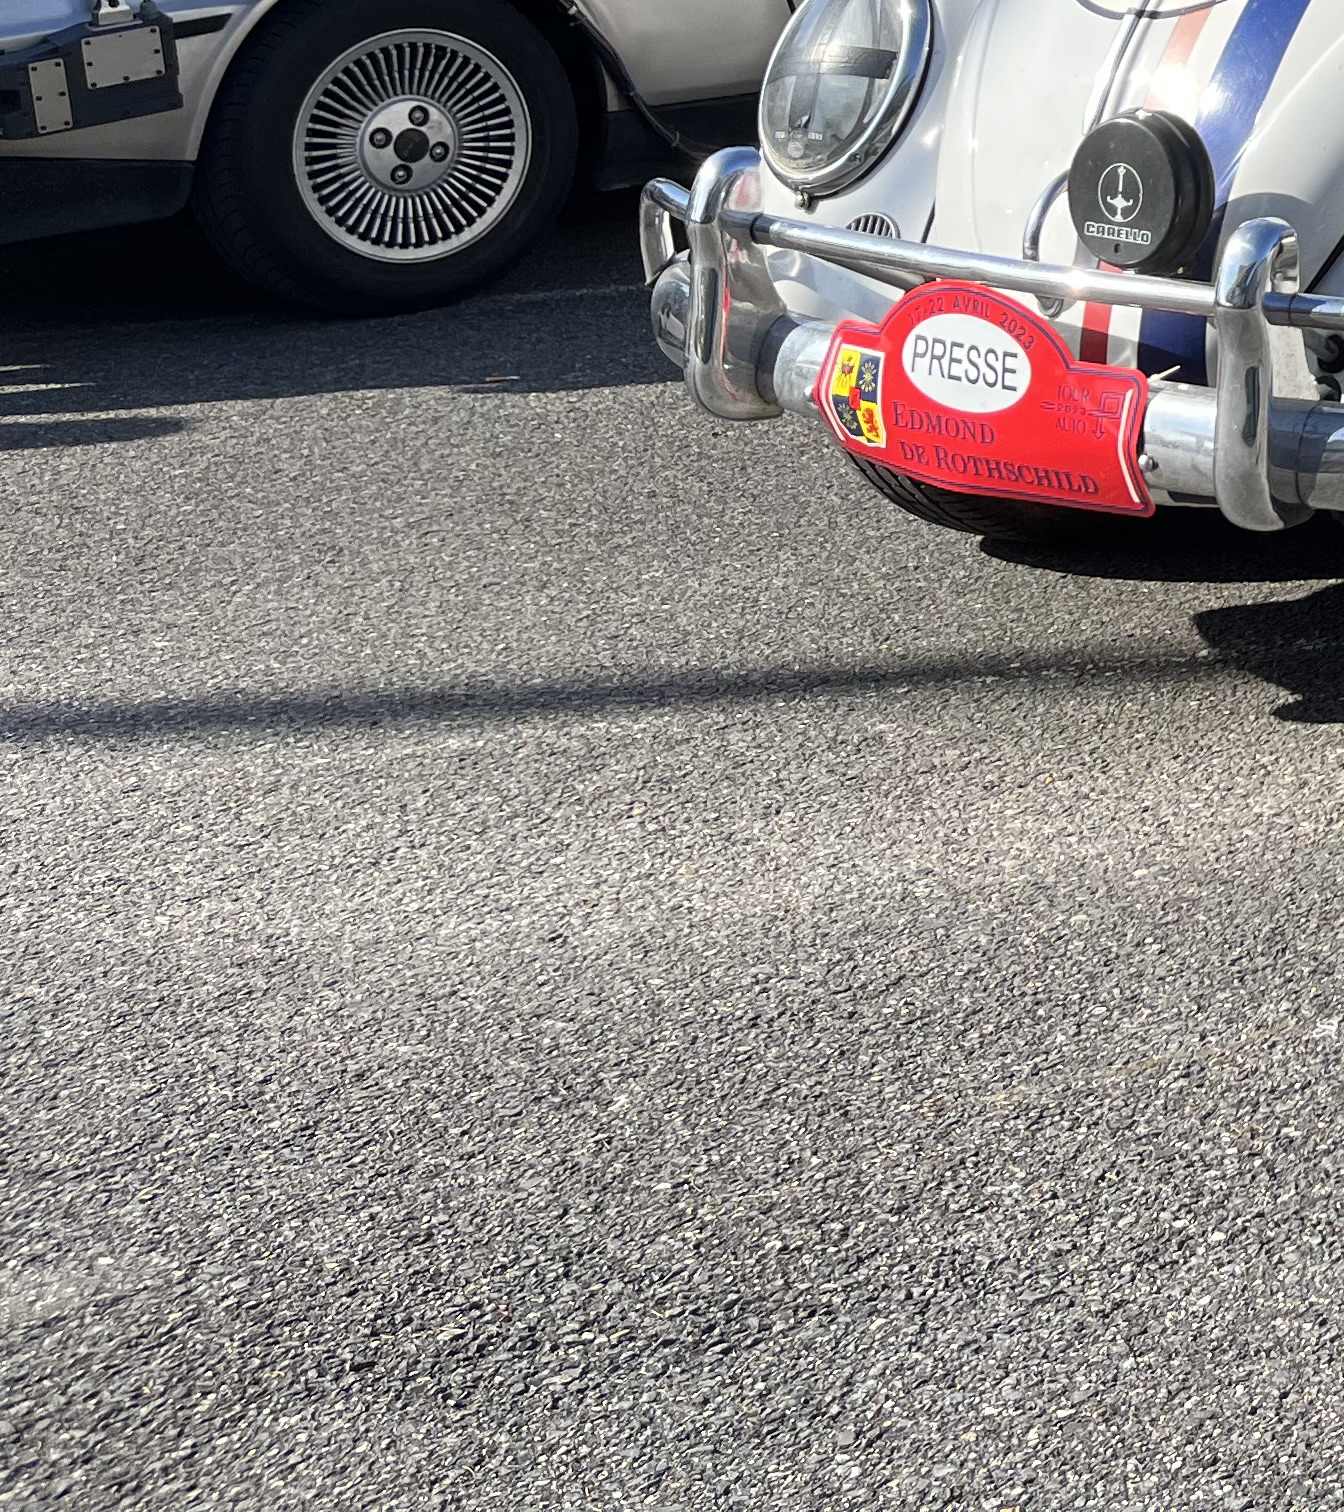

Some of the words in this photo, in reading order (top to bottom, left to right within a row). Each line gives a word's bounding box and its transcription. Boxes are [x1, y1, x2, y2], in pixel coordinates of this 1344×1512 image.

[1084, 221, 1151, 245] CARELLO
[952, 296, 991, 318] AVRIL
[999, 312, 1035, 350] 2023
[911, 334, 1018, 392] PRESSE
[892, 401, 996, 445] EDMOND
[899, 441, 930, 465] DE
[933, 445, 1100, 496] ROTHSCHILD
